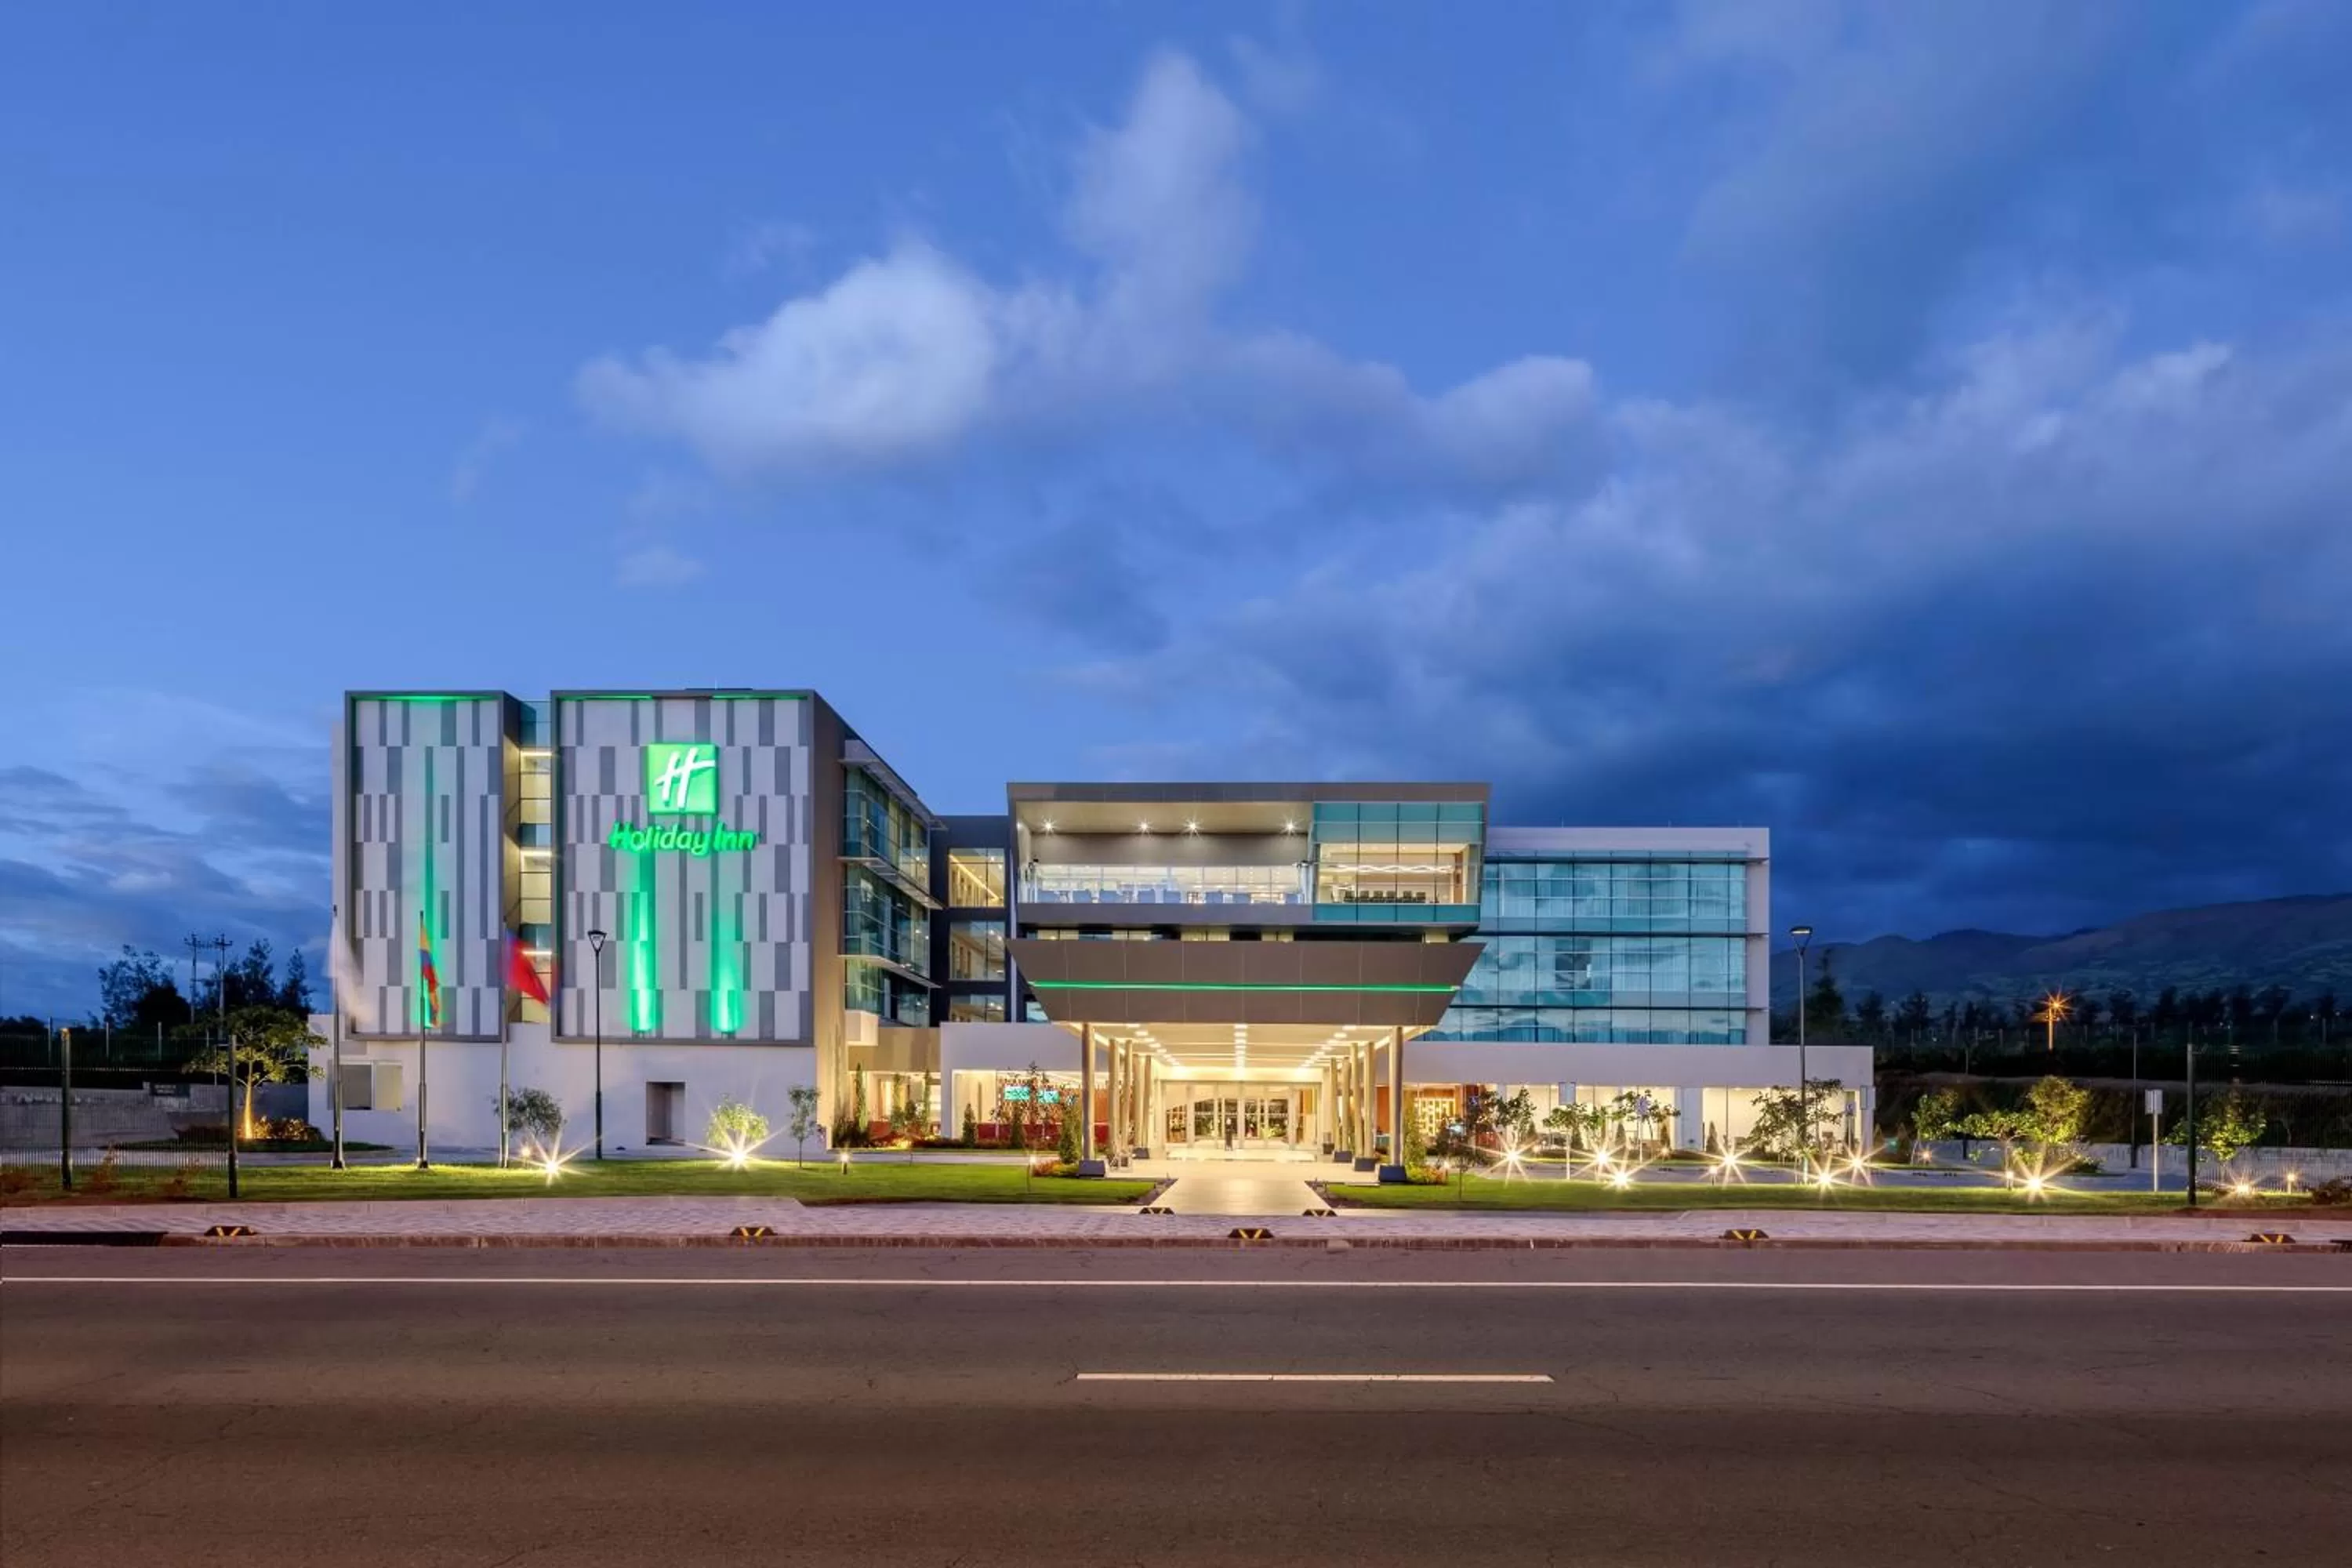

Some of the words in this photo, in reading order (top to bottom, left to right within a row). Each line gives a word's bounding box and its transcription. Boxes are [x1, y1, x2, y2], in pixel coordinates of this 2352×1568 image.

[653, 746, 715, 808] H
[609, 822, 709, 856] Holiday
[713, 822, 757, 851] Inn
